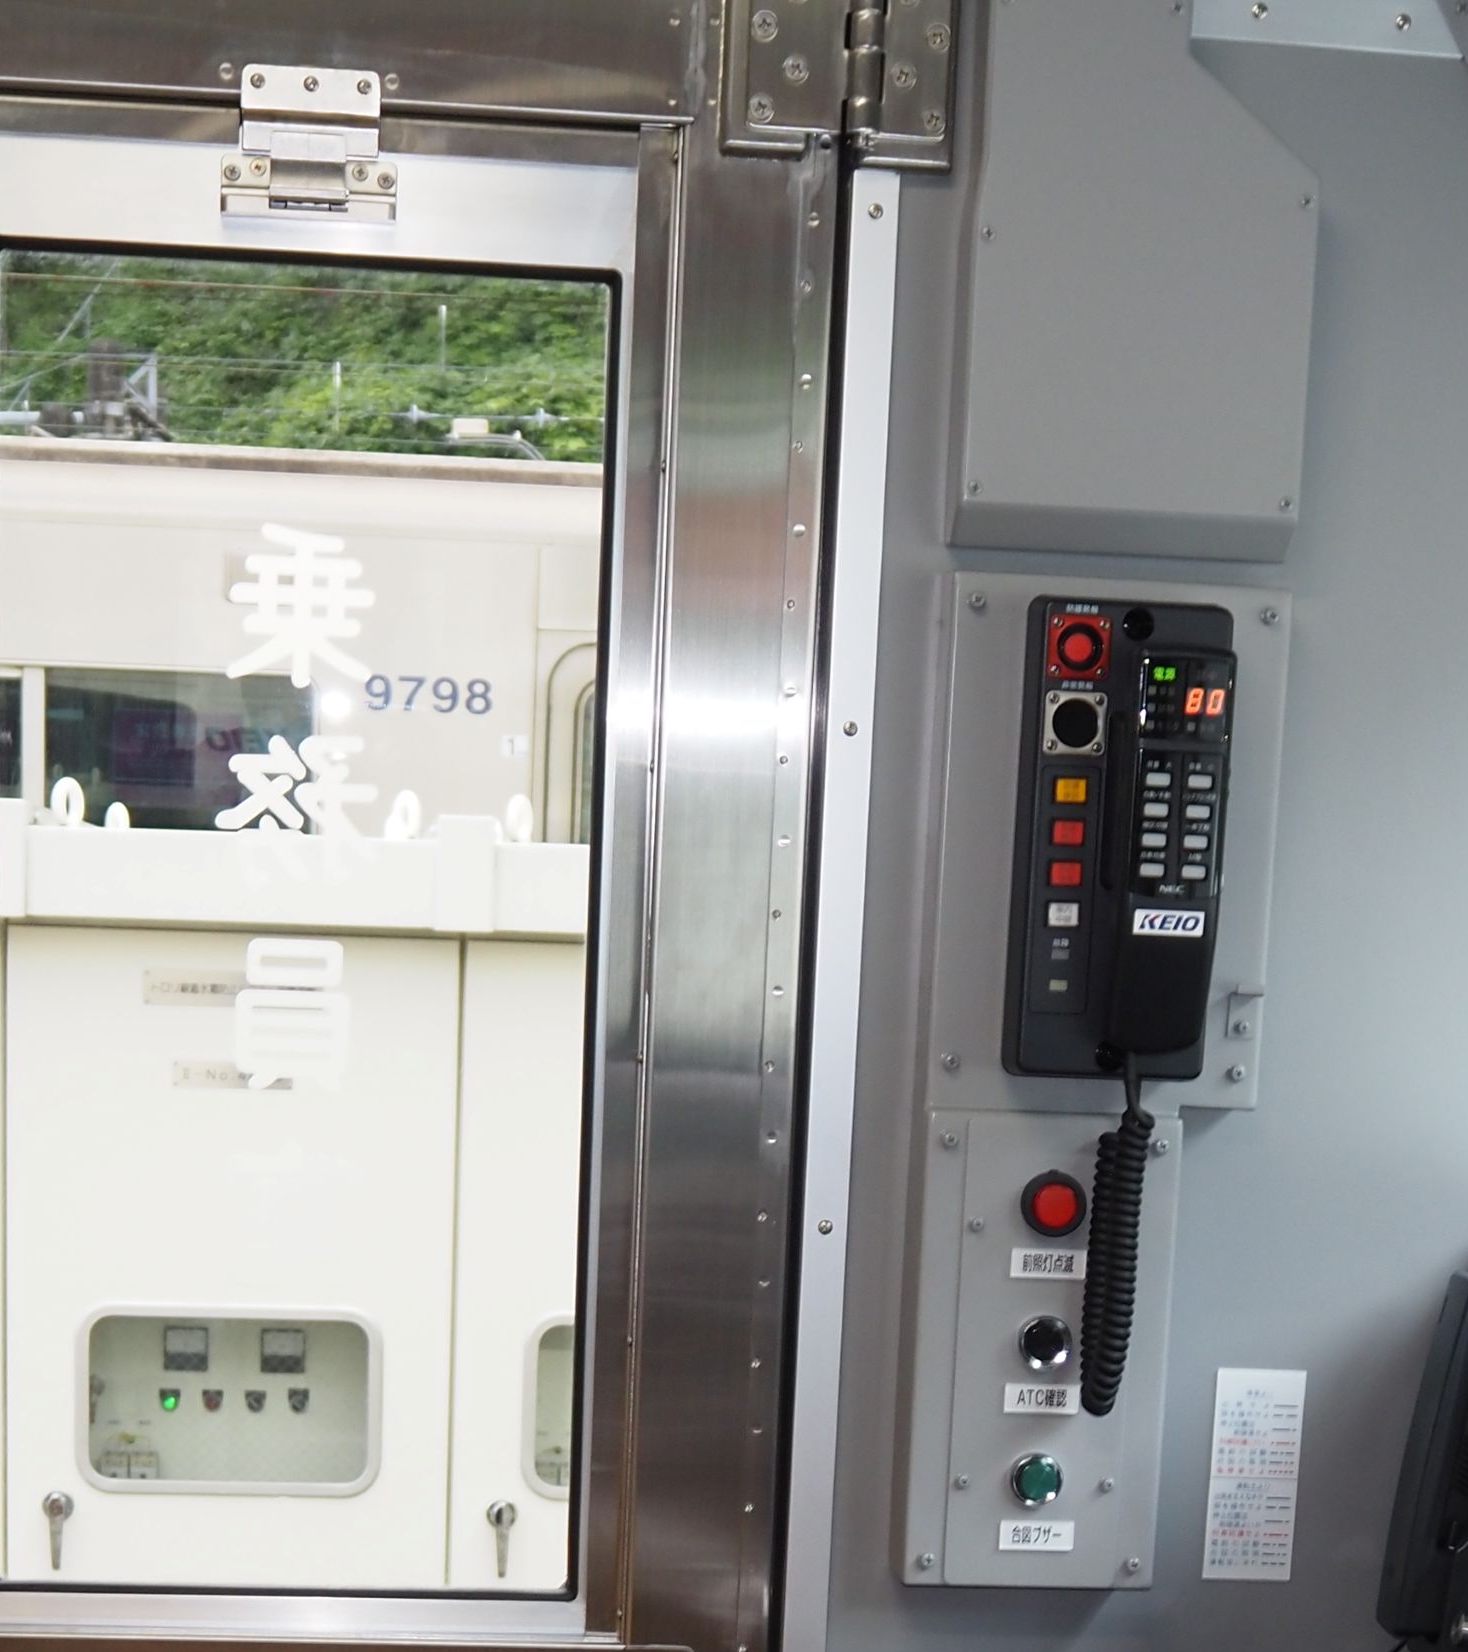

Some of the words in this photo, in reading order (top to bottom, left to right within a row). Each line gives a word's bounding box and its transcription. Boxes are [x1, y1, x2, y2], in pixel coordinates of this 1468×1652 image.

[365, 674, 493, 715] 9798
[1184, 687, 1226, 716] 80
[1159, 884, 1185, 894] NEC
[1139, 913, 1200, 931] KEIO
[1016, 1388, 1068, 1408] ATC確認
[1011, 1525, 1062, 1544] 合図ブザー
